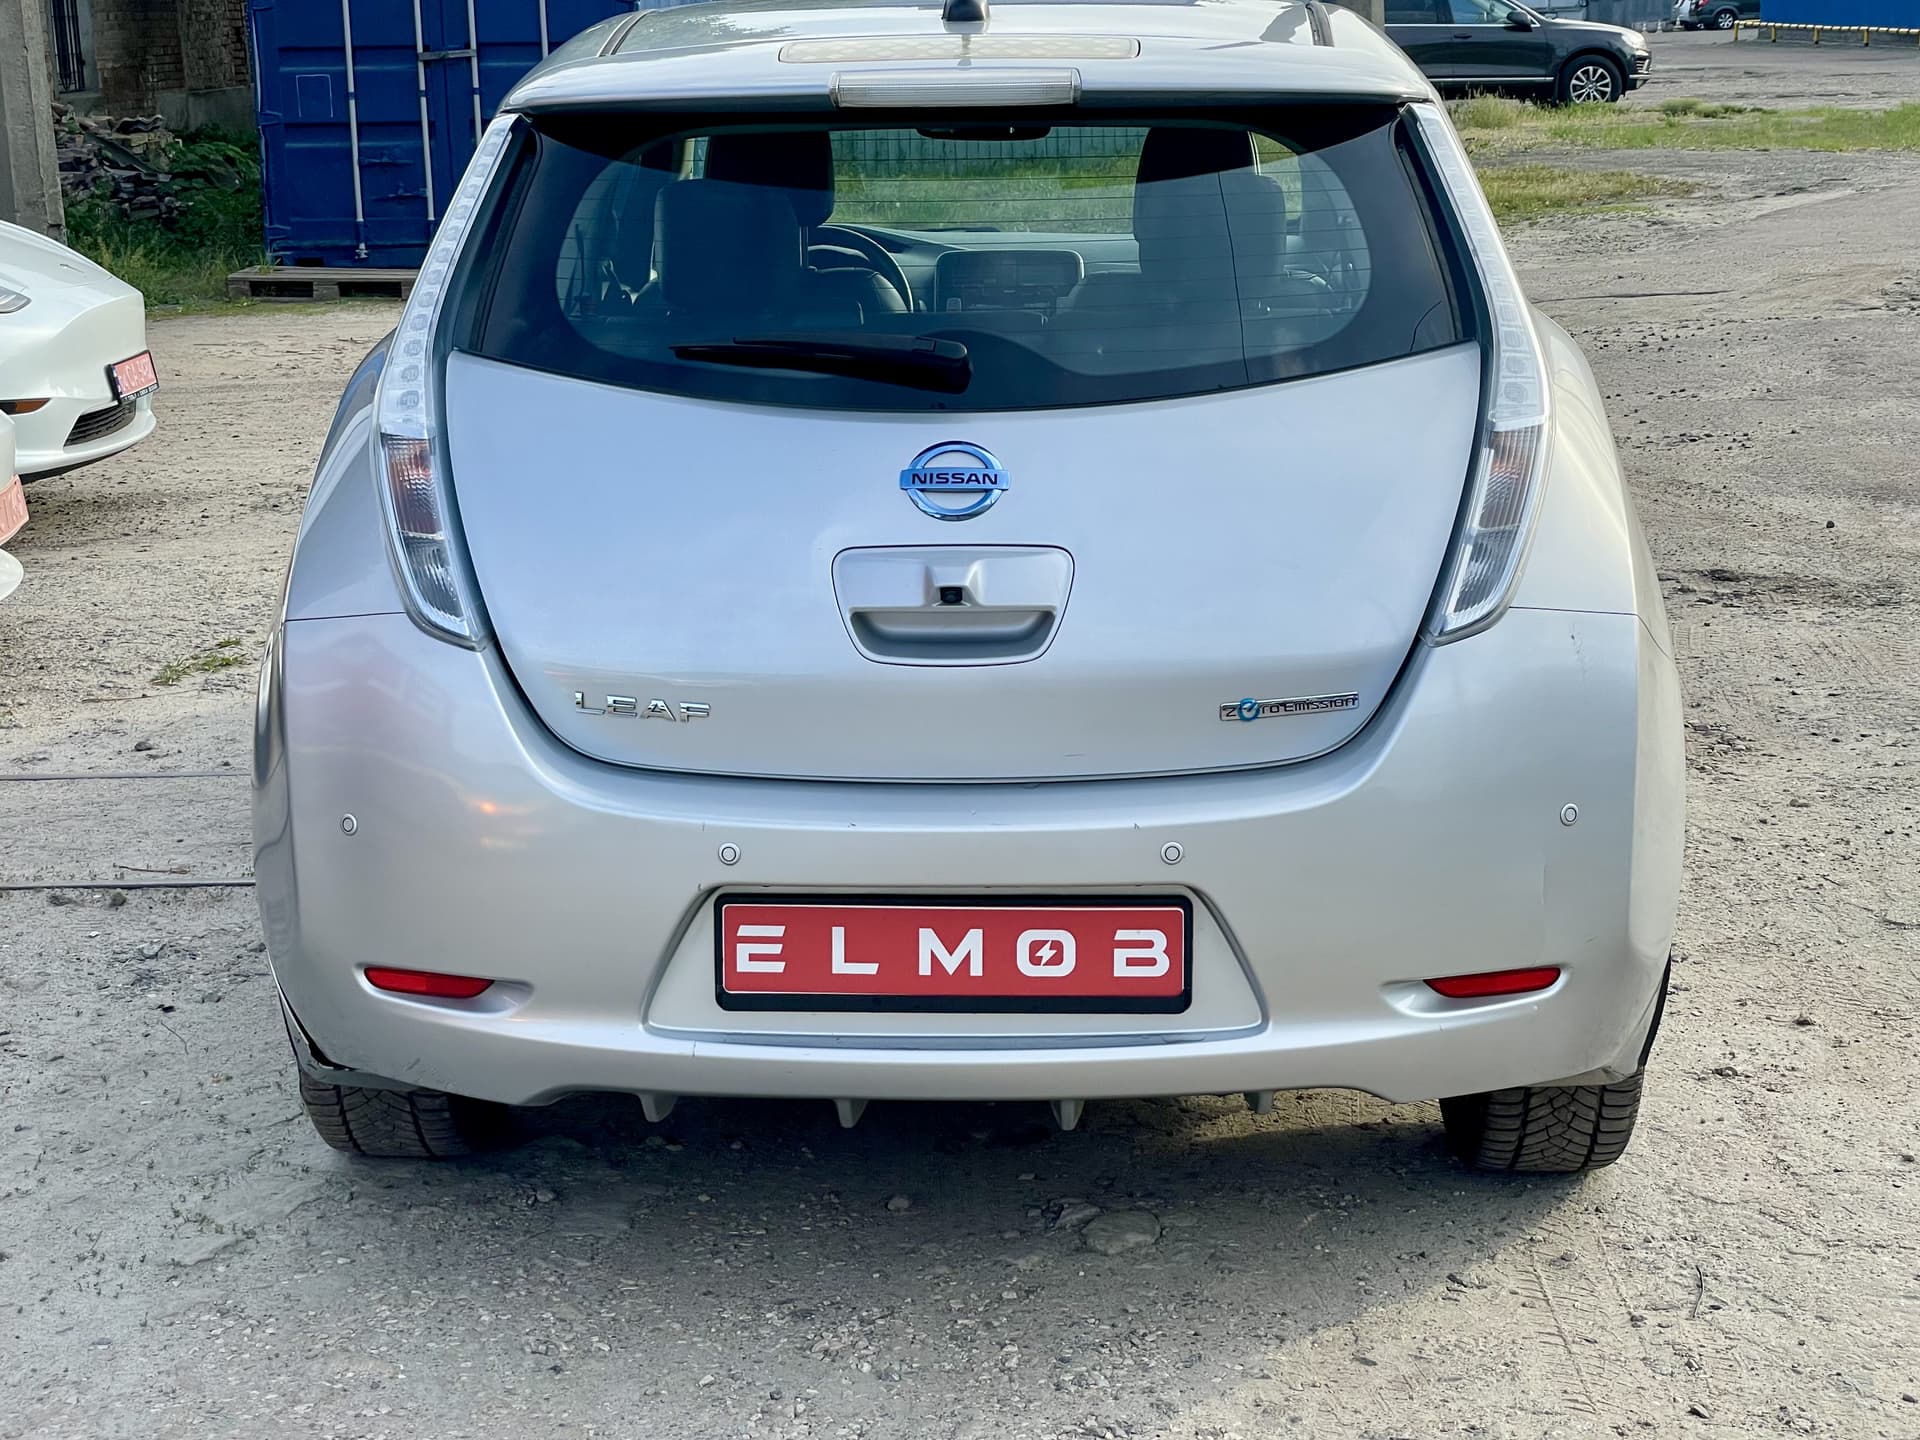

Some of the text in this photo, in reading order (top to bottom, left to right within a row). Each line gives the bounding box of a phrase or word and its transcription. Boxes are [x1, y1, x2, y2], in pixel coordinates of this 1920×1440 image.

[911, 472, 998, 485] NISSAN
[575, 691, 711, 722] LEAF
[736, 924, 1171, 978] ELMOB
